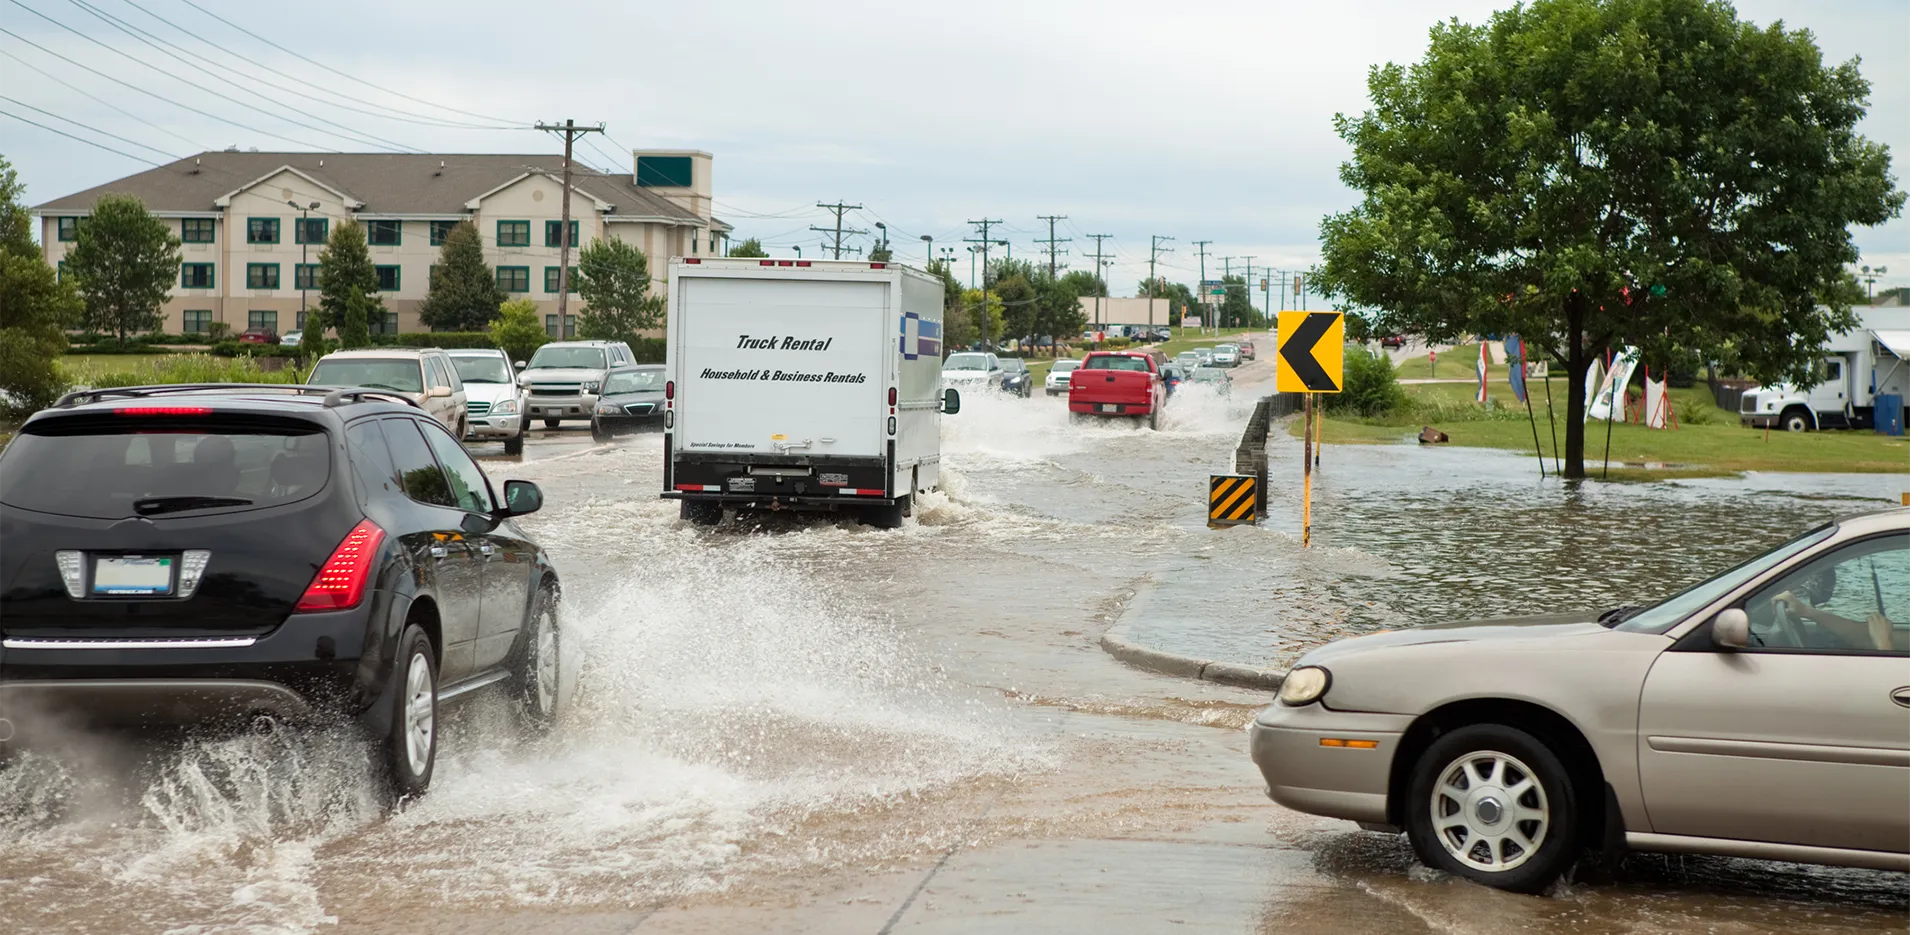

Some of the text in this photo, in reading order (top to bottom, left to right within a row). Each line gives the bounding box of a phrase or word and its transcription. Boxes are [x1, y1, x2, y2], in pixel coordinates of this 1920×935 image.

[737, 334, 833, 351] Truck Rental
[699, 368, 866, 384] Household & Business Rentals
